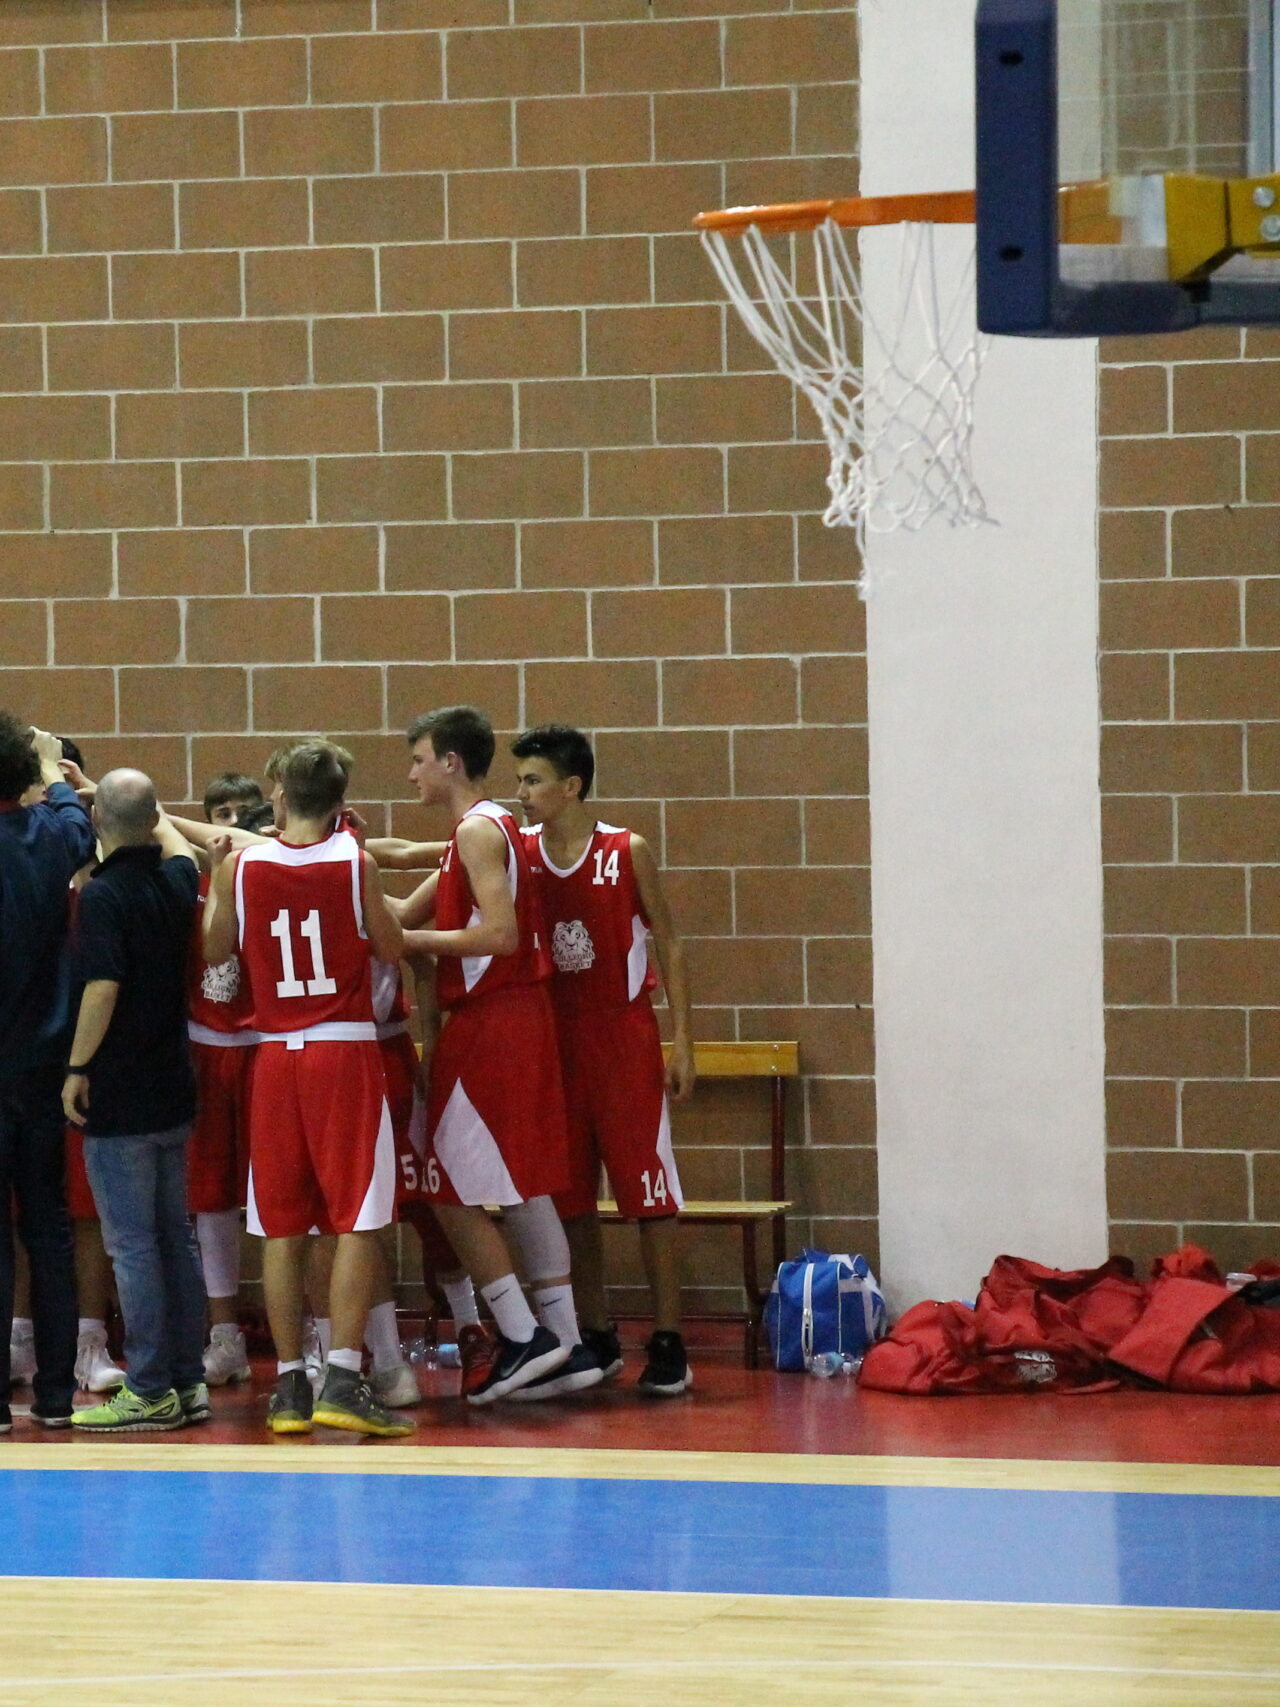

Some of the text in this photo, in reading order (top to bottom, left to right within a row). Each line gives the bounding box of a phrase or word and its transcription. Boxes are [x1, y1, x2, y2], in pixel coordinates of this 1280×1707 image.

[592, 849, 619, 886] 14
[270, 909, 337, 997] 11
[400, 1154, 417, 1190] 5
[641, 1169, 667, 1206] 14
